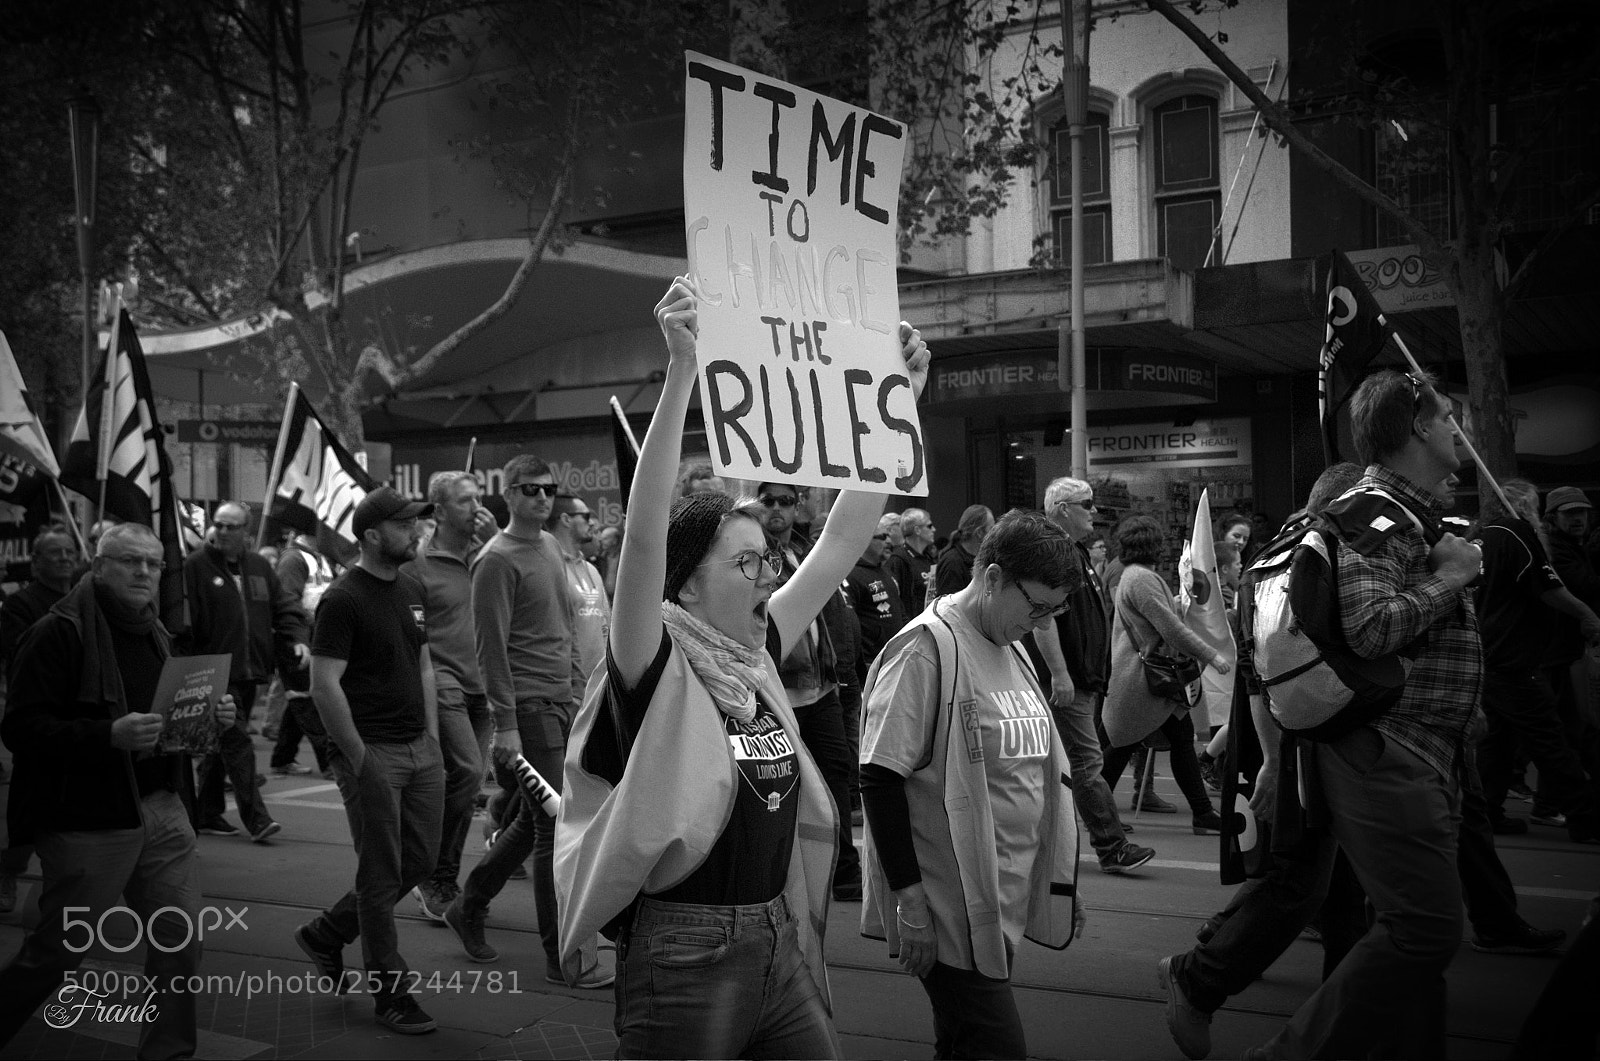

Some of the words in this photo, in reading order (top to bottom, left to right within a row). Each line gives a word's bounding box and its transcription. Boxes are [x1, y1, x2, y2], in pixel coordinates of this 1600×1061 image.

[688, 61, 903, 225] TIME
[759, 191, 809, 242] TO
[687, 216, 891, 335] CHANGE
[1400, 291, 1431, 306] juice
[761, 316, 832, 365] THE
[938, 365, 1034, 389] FRONTIER
[1037, 371, 1059, 382] HEA
[1128, 363, 1202, 386] FRONTIER
[220, 424, 280, 440] vodafon
[705, 360, 923, 493] RULES
[1088, 432, 1196, 452] FRONTIER
[1200, 437, 1238, 447] HEALTH
[394, 463, 424, 500] ill
[598, 497, 622, 527] is
[989, 689, 1028, 718] WE
[1002, 719, 1049, 757] UNIO
[756, 764, 778, 780] LOOKS
[776, 760, 793, 778] LIKE
